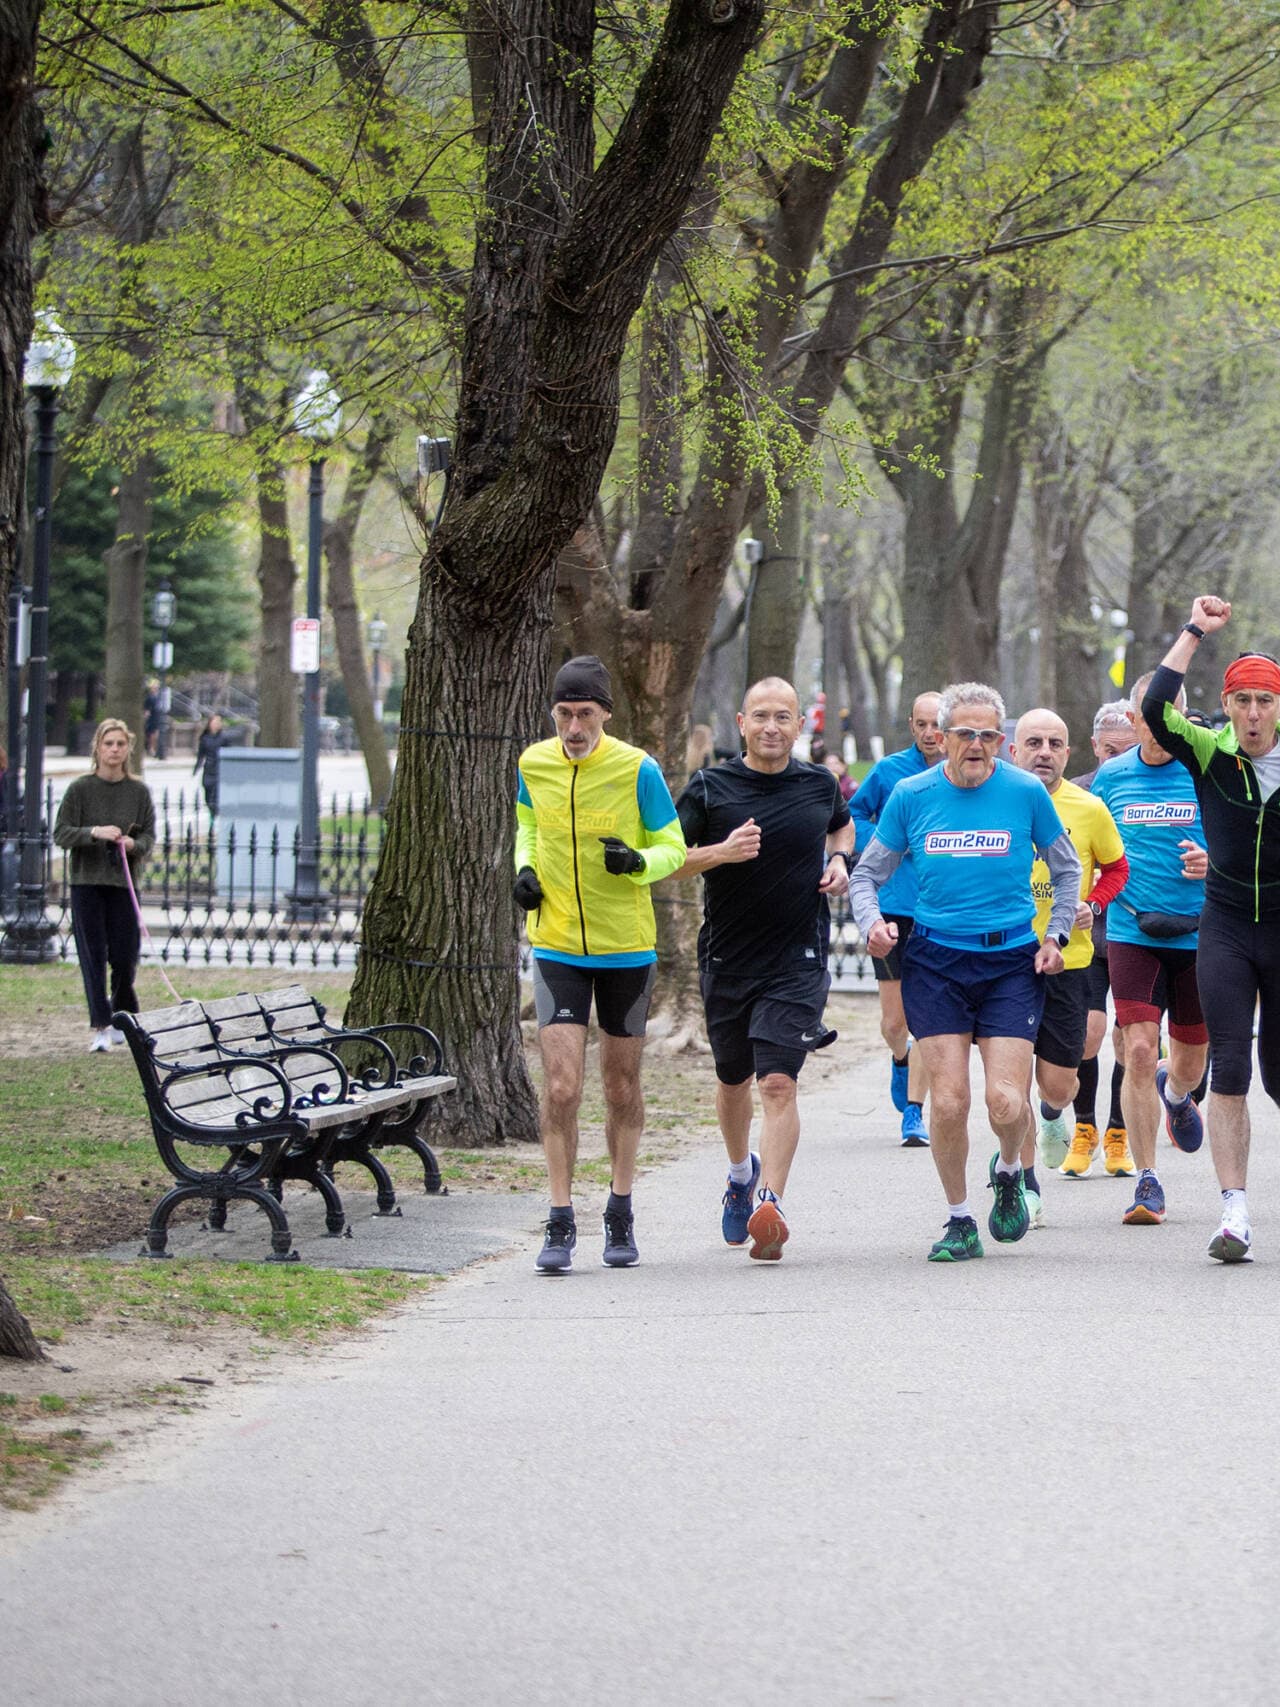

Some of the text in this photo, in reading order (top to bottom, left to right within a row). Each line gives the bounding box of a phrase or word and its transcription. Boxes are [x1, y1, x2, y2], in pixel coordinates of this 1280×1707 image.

[1127, 805, 1192, 819] Born2Run
[929, 833, 1005, 849] Born2Run
[1031, 881, 1052, 891] VIO
